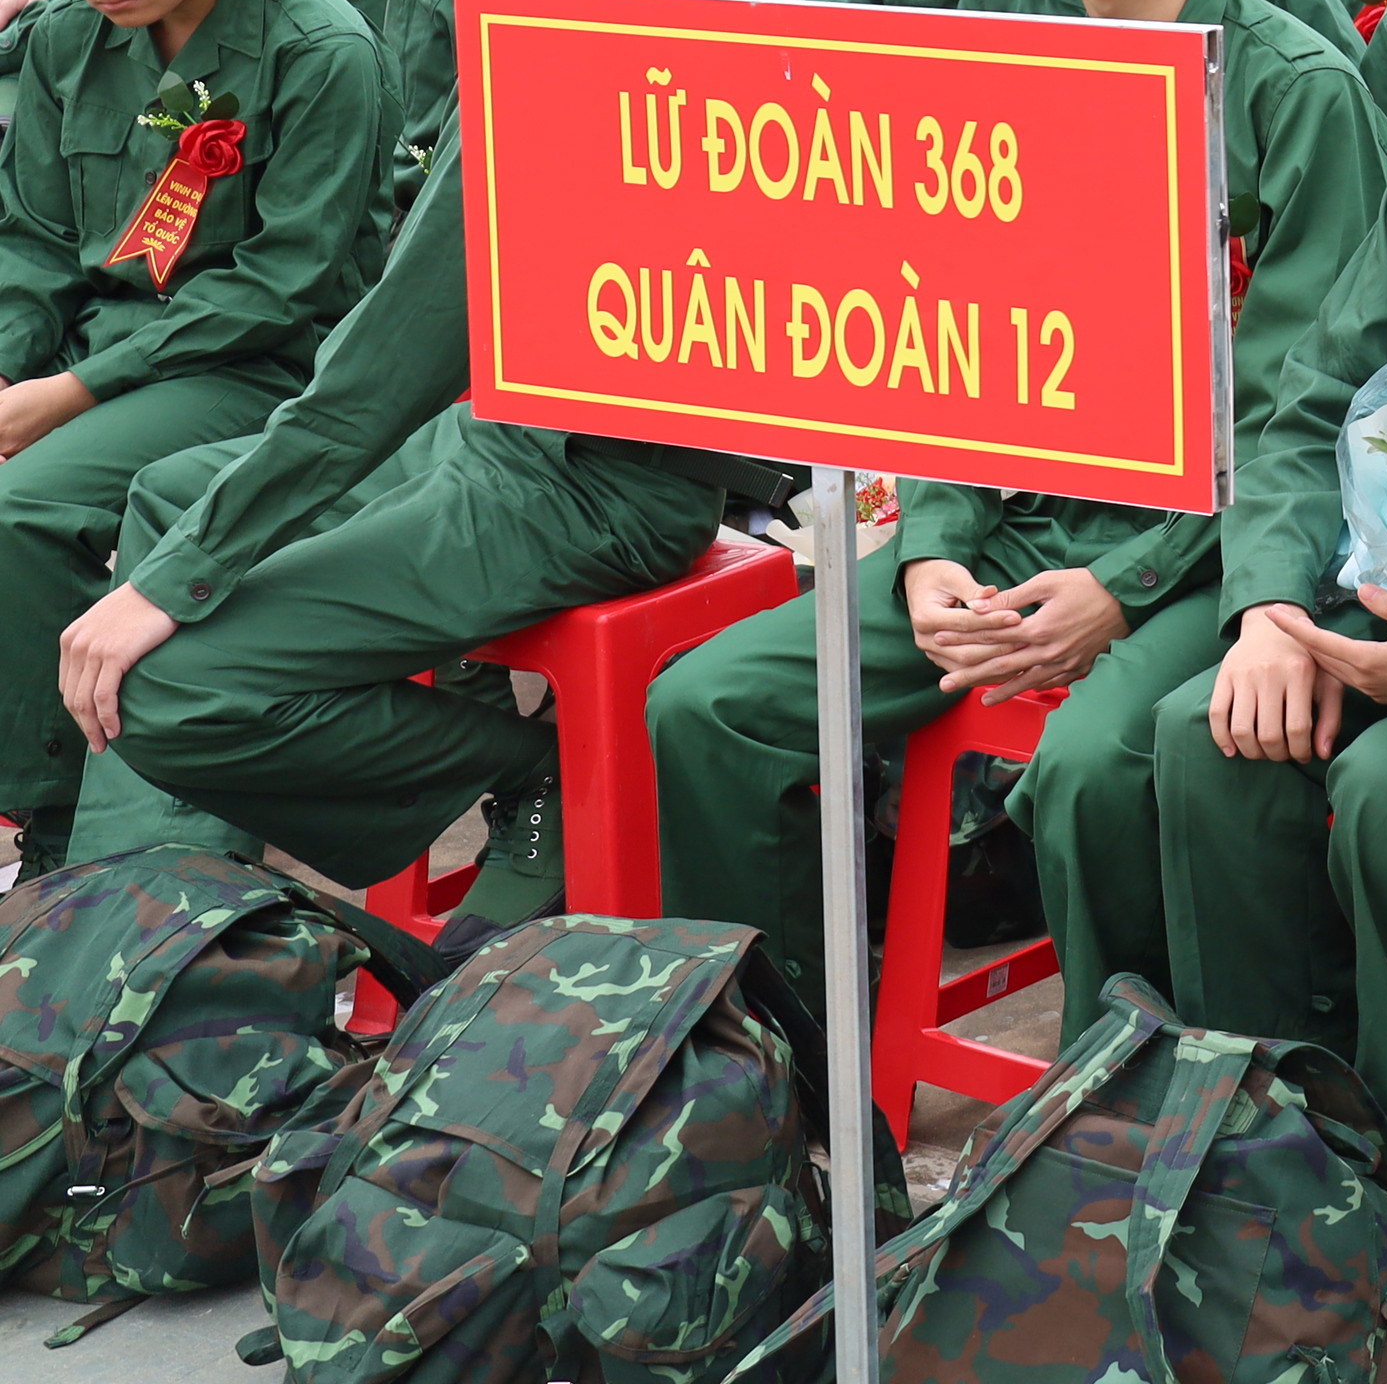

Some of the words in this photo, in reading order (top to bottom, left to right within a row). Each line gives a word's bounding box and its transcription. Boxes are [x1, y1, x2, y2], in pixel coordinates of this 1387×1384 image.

[620, 66, 687, 190] LỮ
[702, 72, 894, 209] ĐOÀN
[914, 115, 1023, 223] 368
[155, 192, 173, 206] LÊN
[169, 180, 192, 197] VINH
[154, 208, 175, 224] BẢO
[174, 217, 188, 231] VỆ
[142, 220, 159, 233] TỔ
[155, 228, 180, 244] QUỐC
[587, 248, 766, 373] QUÂN
[785, 260, 980, 399] ĐOÀN
[1010, 307, 1076, 410] 12
